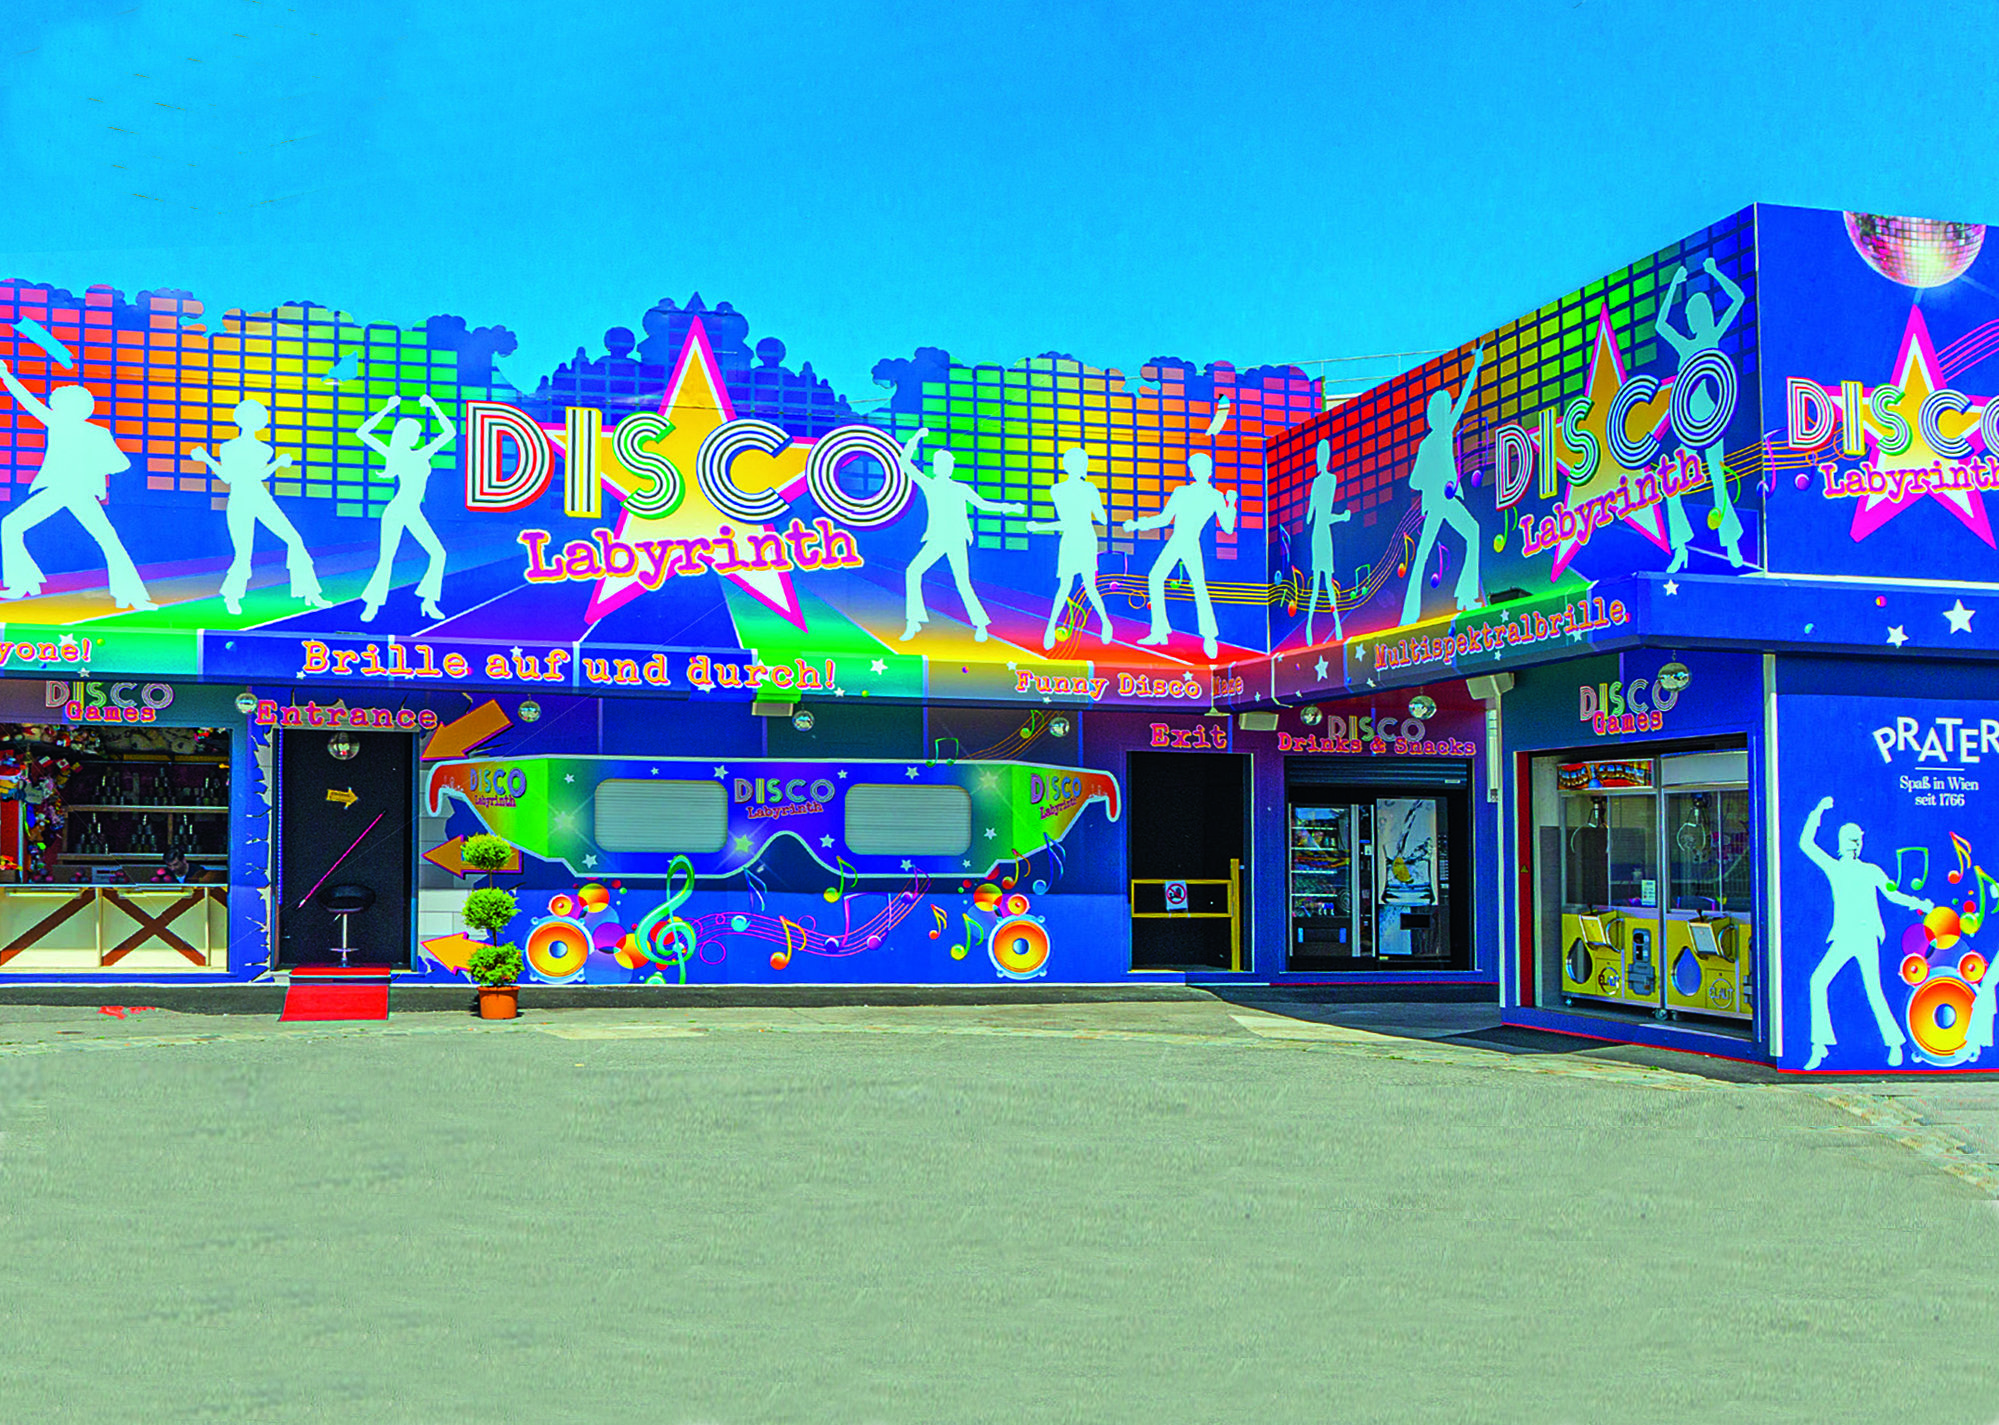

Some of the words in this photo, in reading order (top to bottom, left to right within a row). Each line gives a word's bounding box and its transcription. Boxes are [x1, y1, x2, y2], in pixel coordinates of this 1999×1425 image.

[1495, 347, 1739, 512] DISCO
[465, 400, 917, 531] DISCO
[1819, 455, 1999, 502] Labyrinth
[1519, 447, 1706, 558] Labyrinth
[517, 518, 864, 592] Labyrinth
[1374, 597, 1627, 671] Multispektralbrille
[302, 639, 466, 678] Brille
[485, 648, 570, 681] auf
[582, 653, 669, 686] und
[686, 656, 836, 689] durch!
[46, 681, 174, 709] DISCO
[1015, 670, 1109, 700] Funny
[1118, 672, 1202, 699] Disco
[1213, 675, 1244, 699] Maze
[1580, 677, 1679, 722] DISCO
[65, 700, 156, 722] Games
[255, 700, 439, 730] Entrance
[1593, 710, 1663, 736] Games
[1150, 722, 1227, 748] Exit
[1277, 731, 1362, 753] Drinks
[1370, 735, 1386, 754] &
[1394, 736, 1477, 755] Snacks
[1327, 715, 1426, 742] DISCO
[1872, 716, 1999, 764] PRATER
[470, 767, 528, 798] DISCO
[734, 778, 836, 804] DISCO
[1030, 773, 1082, 805] DISCO
[1900, 775, 1931, 792] Spaß
[1933, 777, 1945, 790] in
[1947, 776, 1979, 791] Wien
[745, 800, 824, 819] Labyrinth
[1915, 793, 1937, 806] seit
[1939, 793, 1966, 806] 1766
